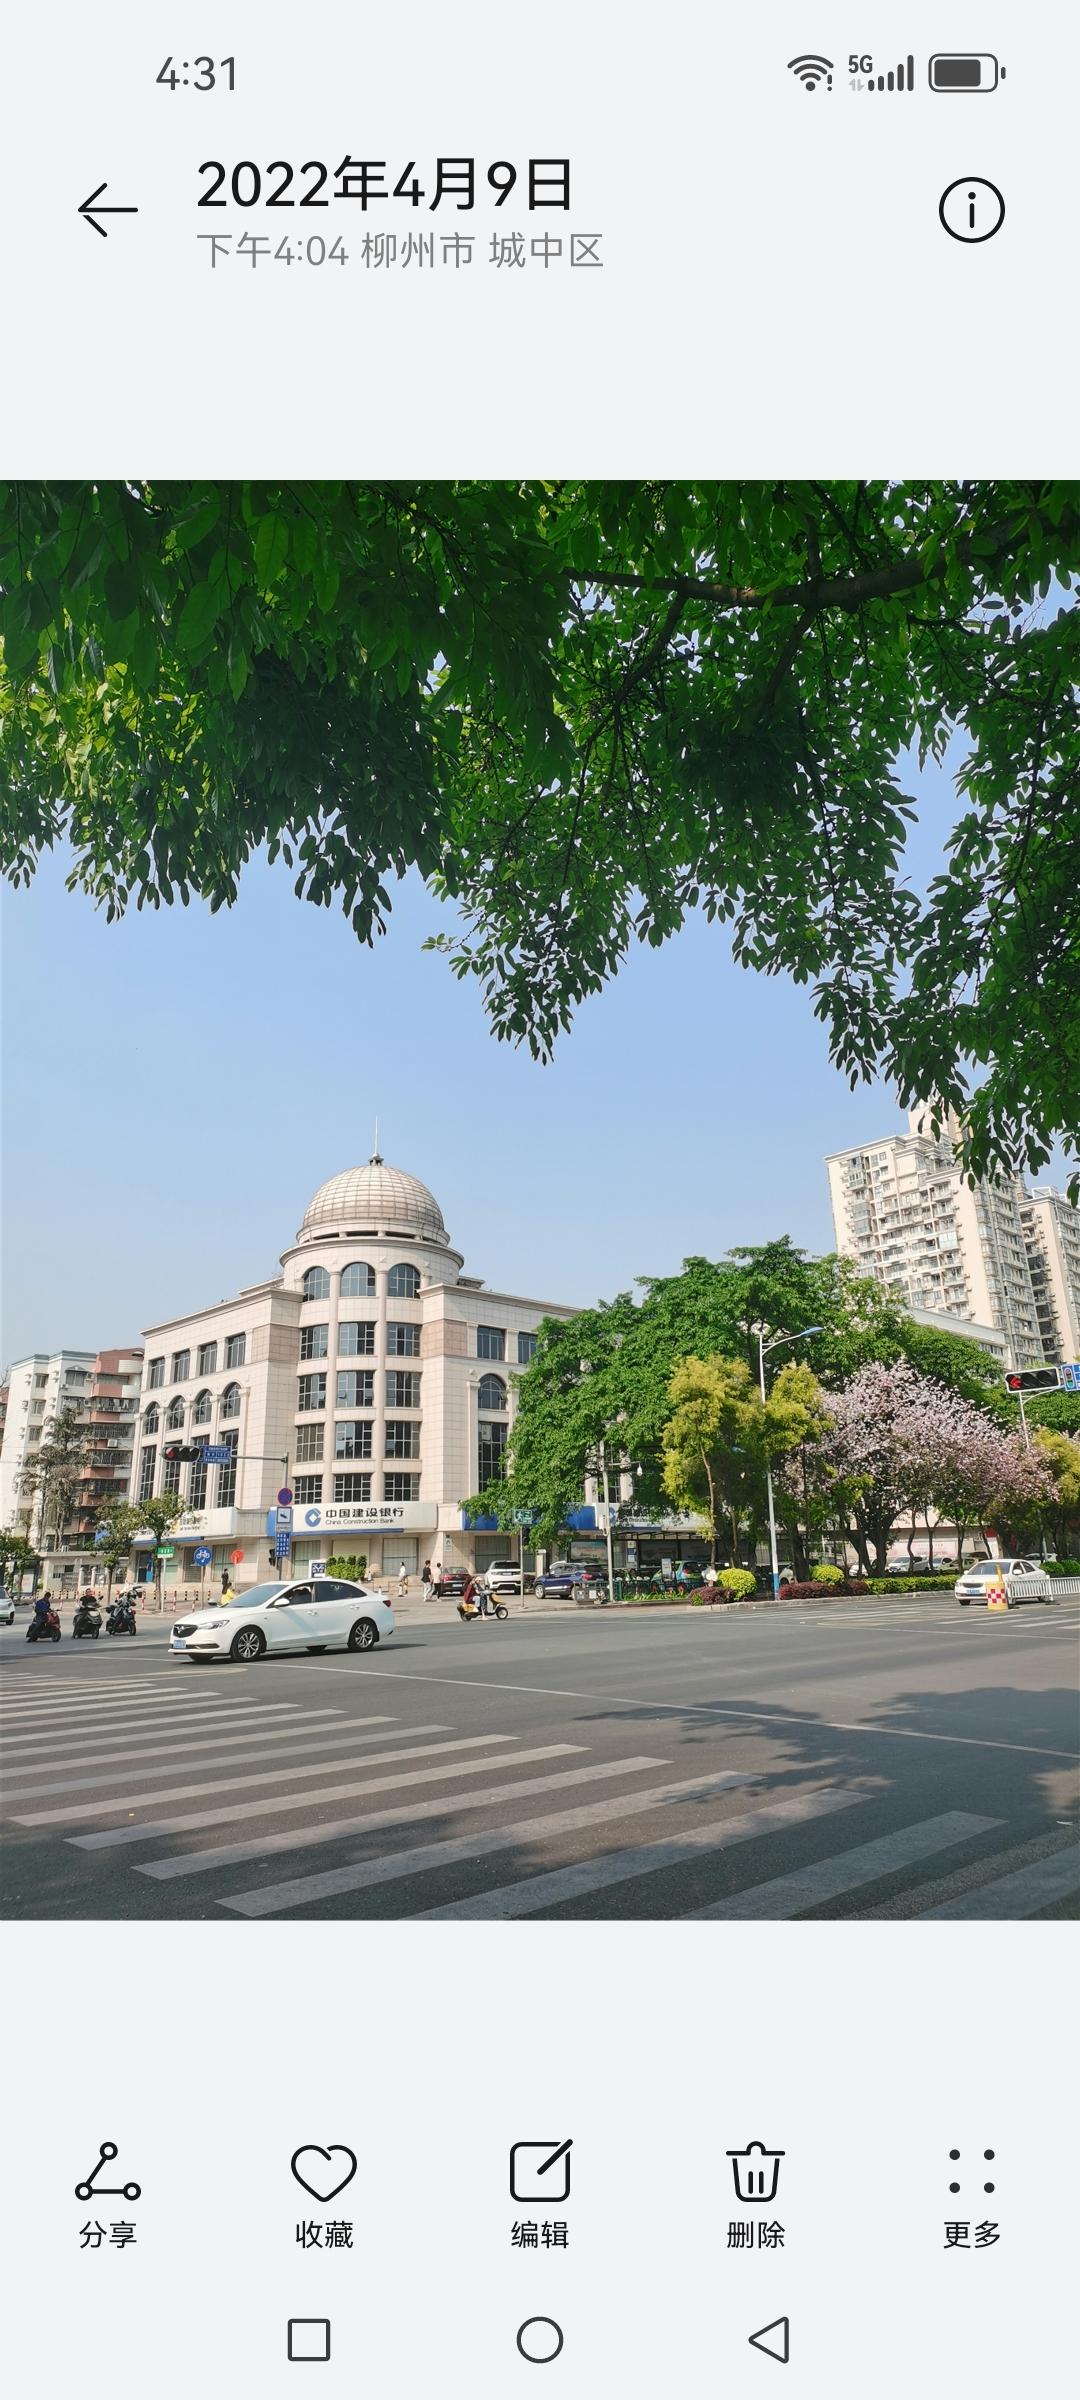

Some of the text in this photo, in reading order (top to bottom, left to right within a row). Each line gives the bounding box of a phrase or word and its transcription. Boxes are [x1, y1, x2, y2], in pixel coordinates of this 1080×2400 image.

[326, 1507, 404, 1518] 中国建设银行
